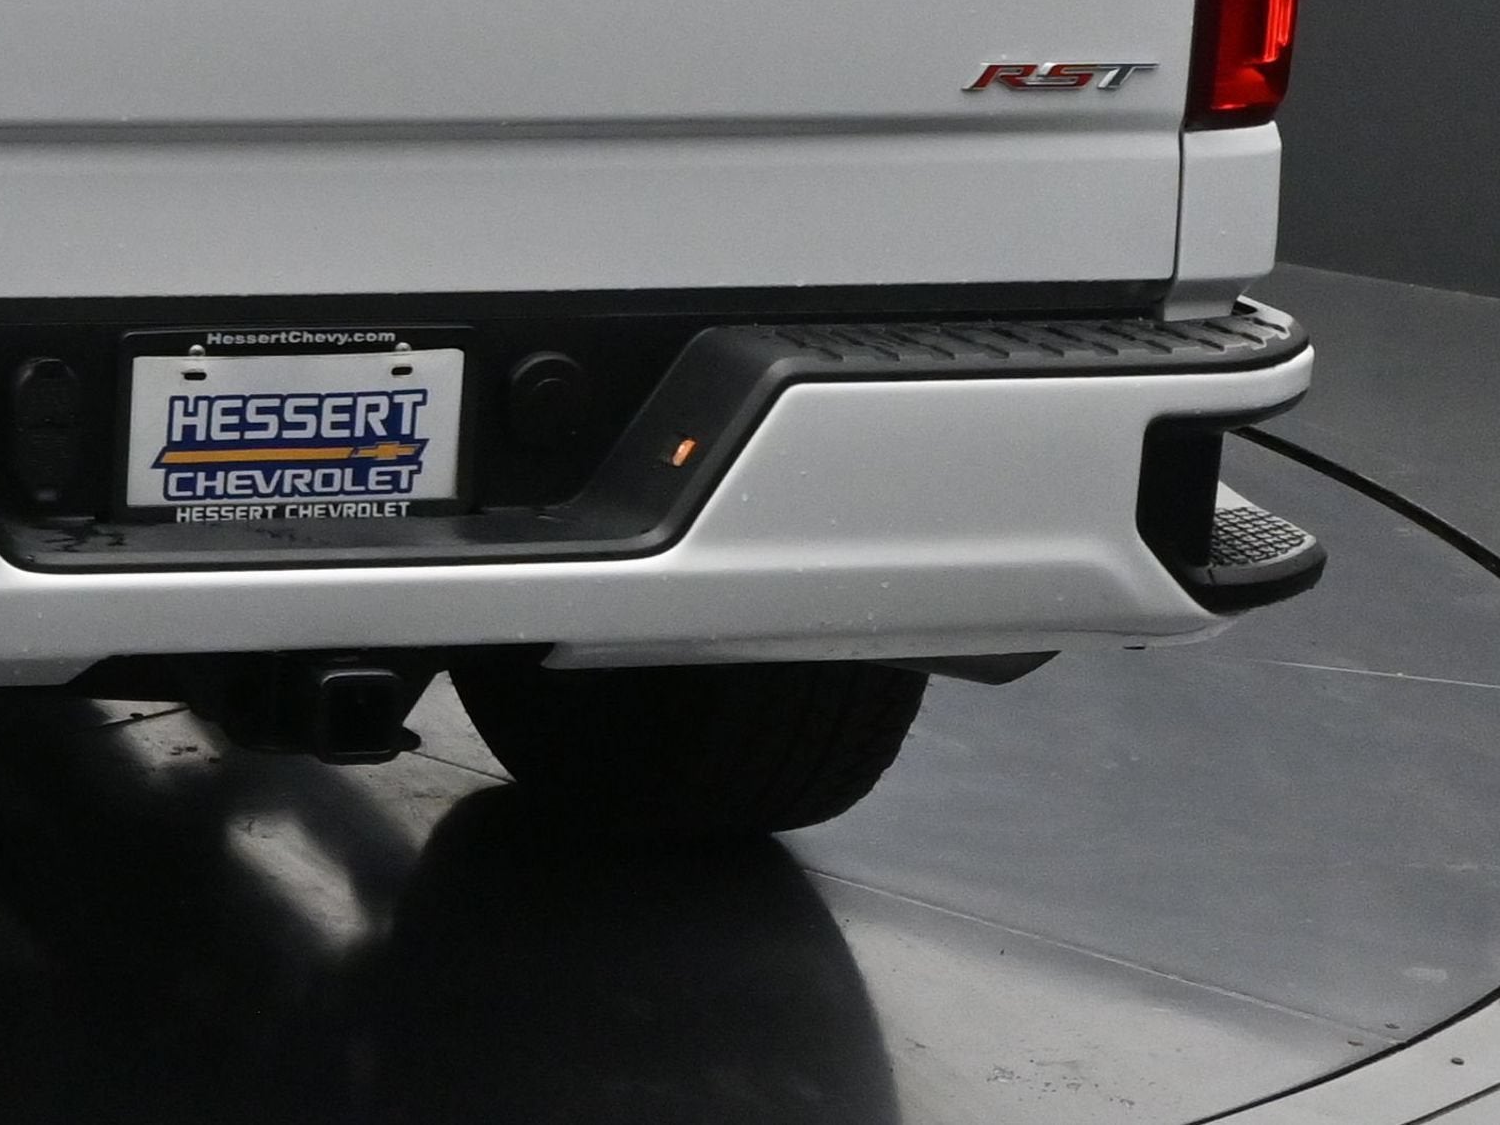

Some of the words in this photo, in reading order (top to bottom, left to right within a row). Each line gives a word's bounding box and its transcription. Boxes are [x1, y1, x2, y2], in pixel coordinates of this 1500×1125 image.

[961, 62, 1158, 91] RST
[206, 331, 397, 346] HessertChevy.com
[168, 391, 427, 442] HESSERT
[166, 465, 421, 498] CHEVROLET
[175, 505, 277, 524] HESSERT
[285, 501, 411, 520] CHEVROLET
